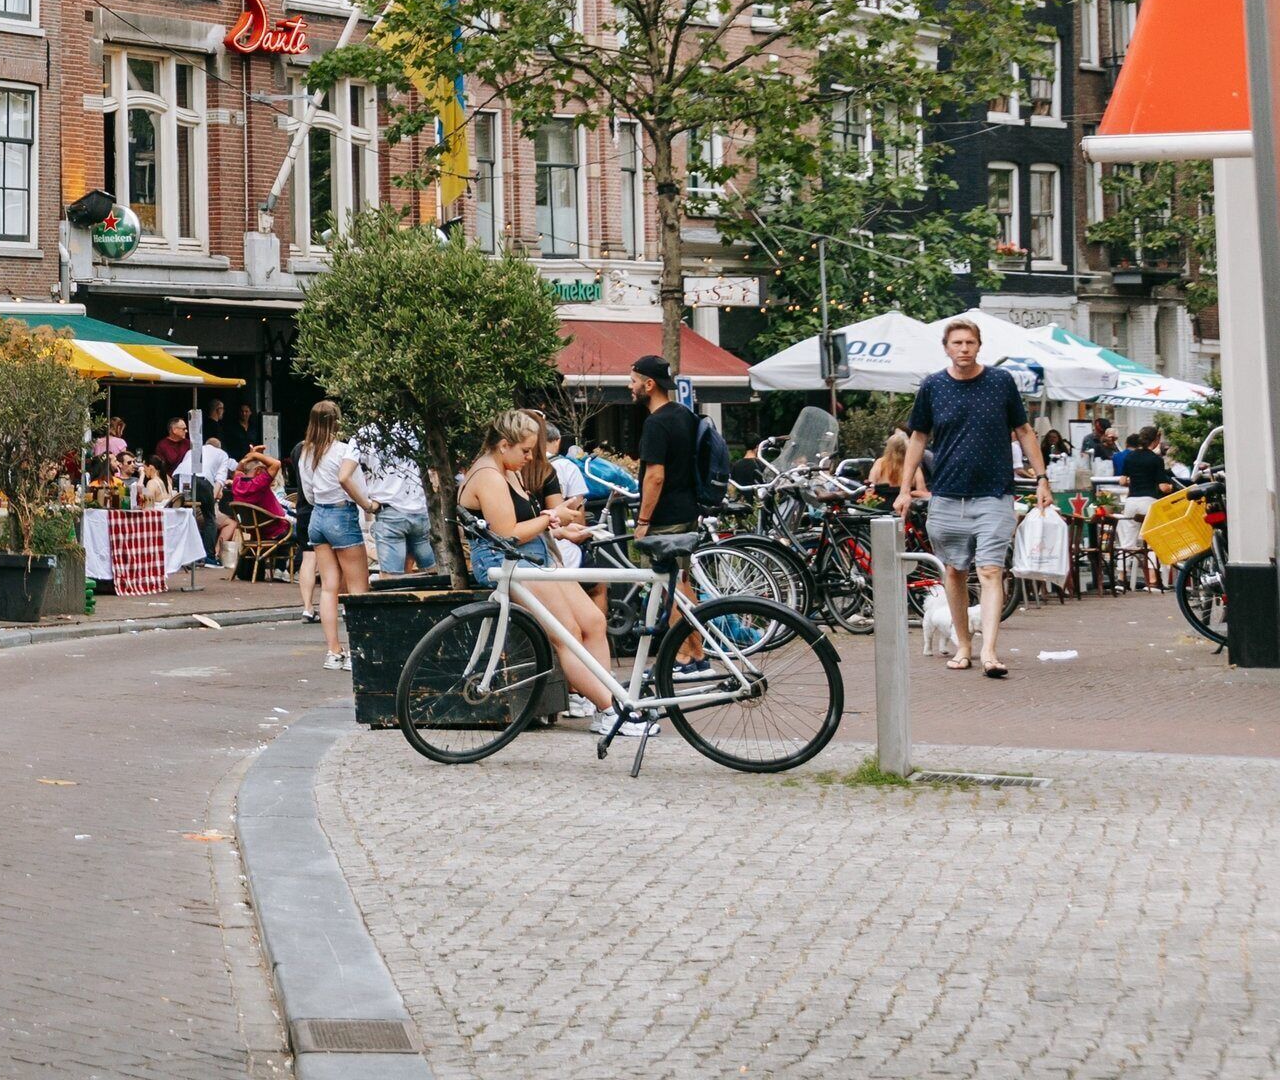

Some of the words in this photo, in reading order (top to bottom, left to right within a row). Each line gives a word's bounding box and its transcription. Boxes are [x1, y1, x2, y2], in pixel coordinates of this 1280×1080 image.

[93, 234, 133, 243] Heineken
[544, 278, 603, 302] eineken
[679, 381, 690, 402] P
[1096, 394, 1190, 412] Heineken
